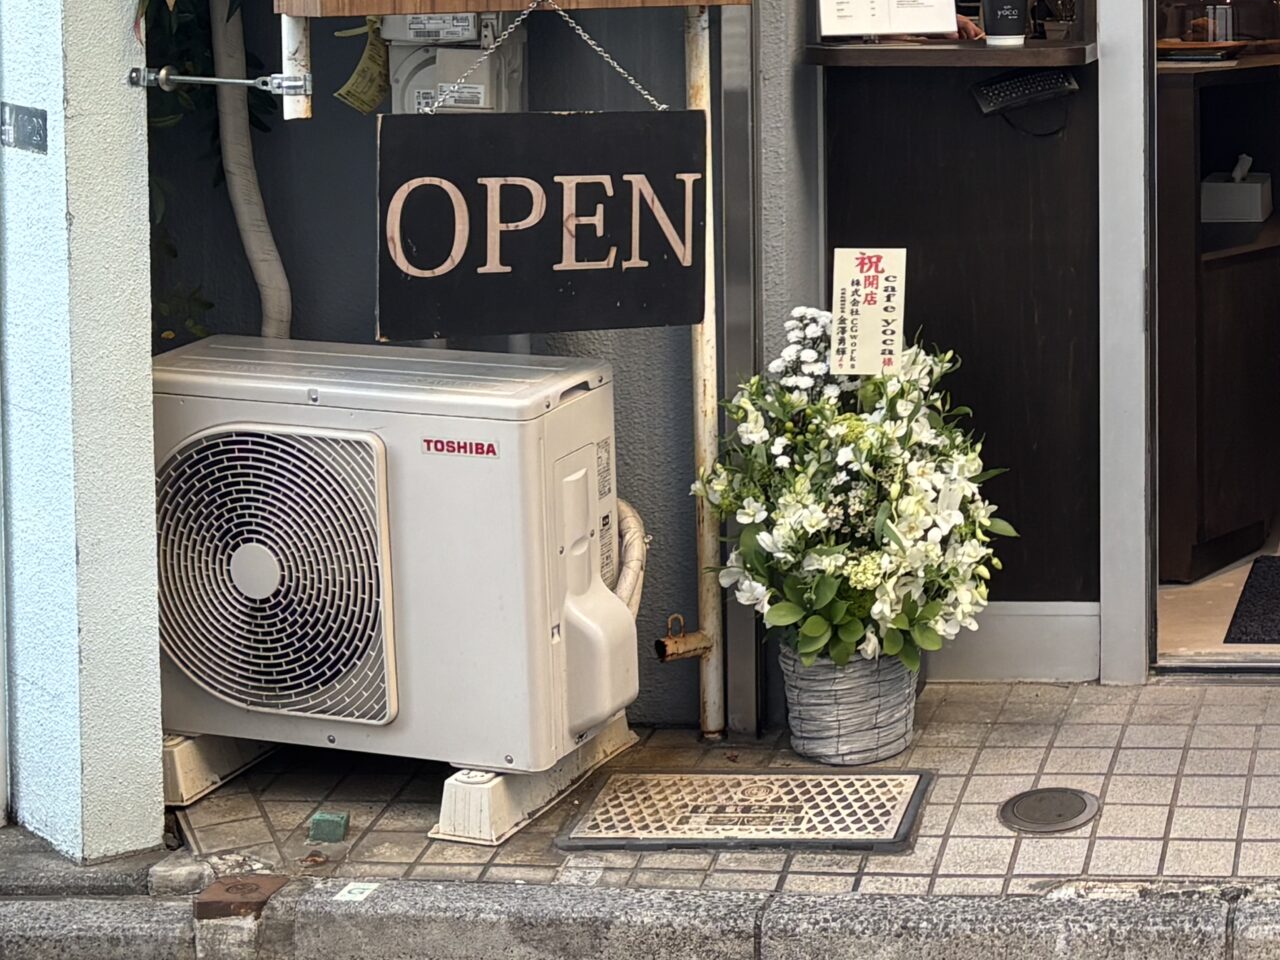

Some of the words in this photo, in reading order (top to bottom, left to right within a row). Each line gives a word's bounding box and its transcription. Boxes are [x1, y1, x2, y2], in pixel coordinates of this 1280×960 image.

[386, 172, 703, 278] OPEN
[882, 274, 898, 313] cafe
[422, 438, 498, 456] TOSHIBA
